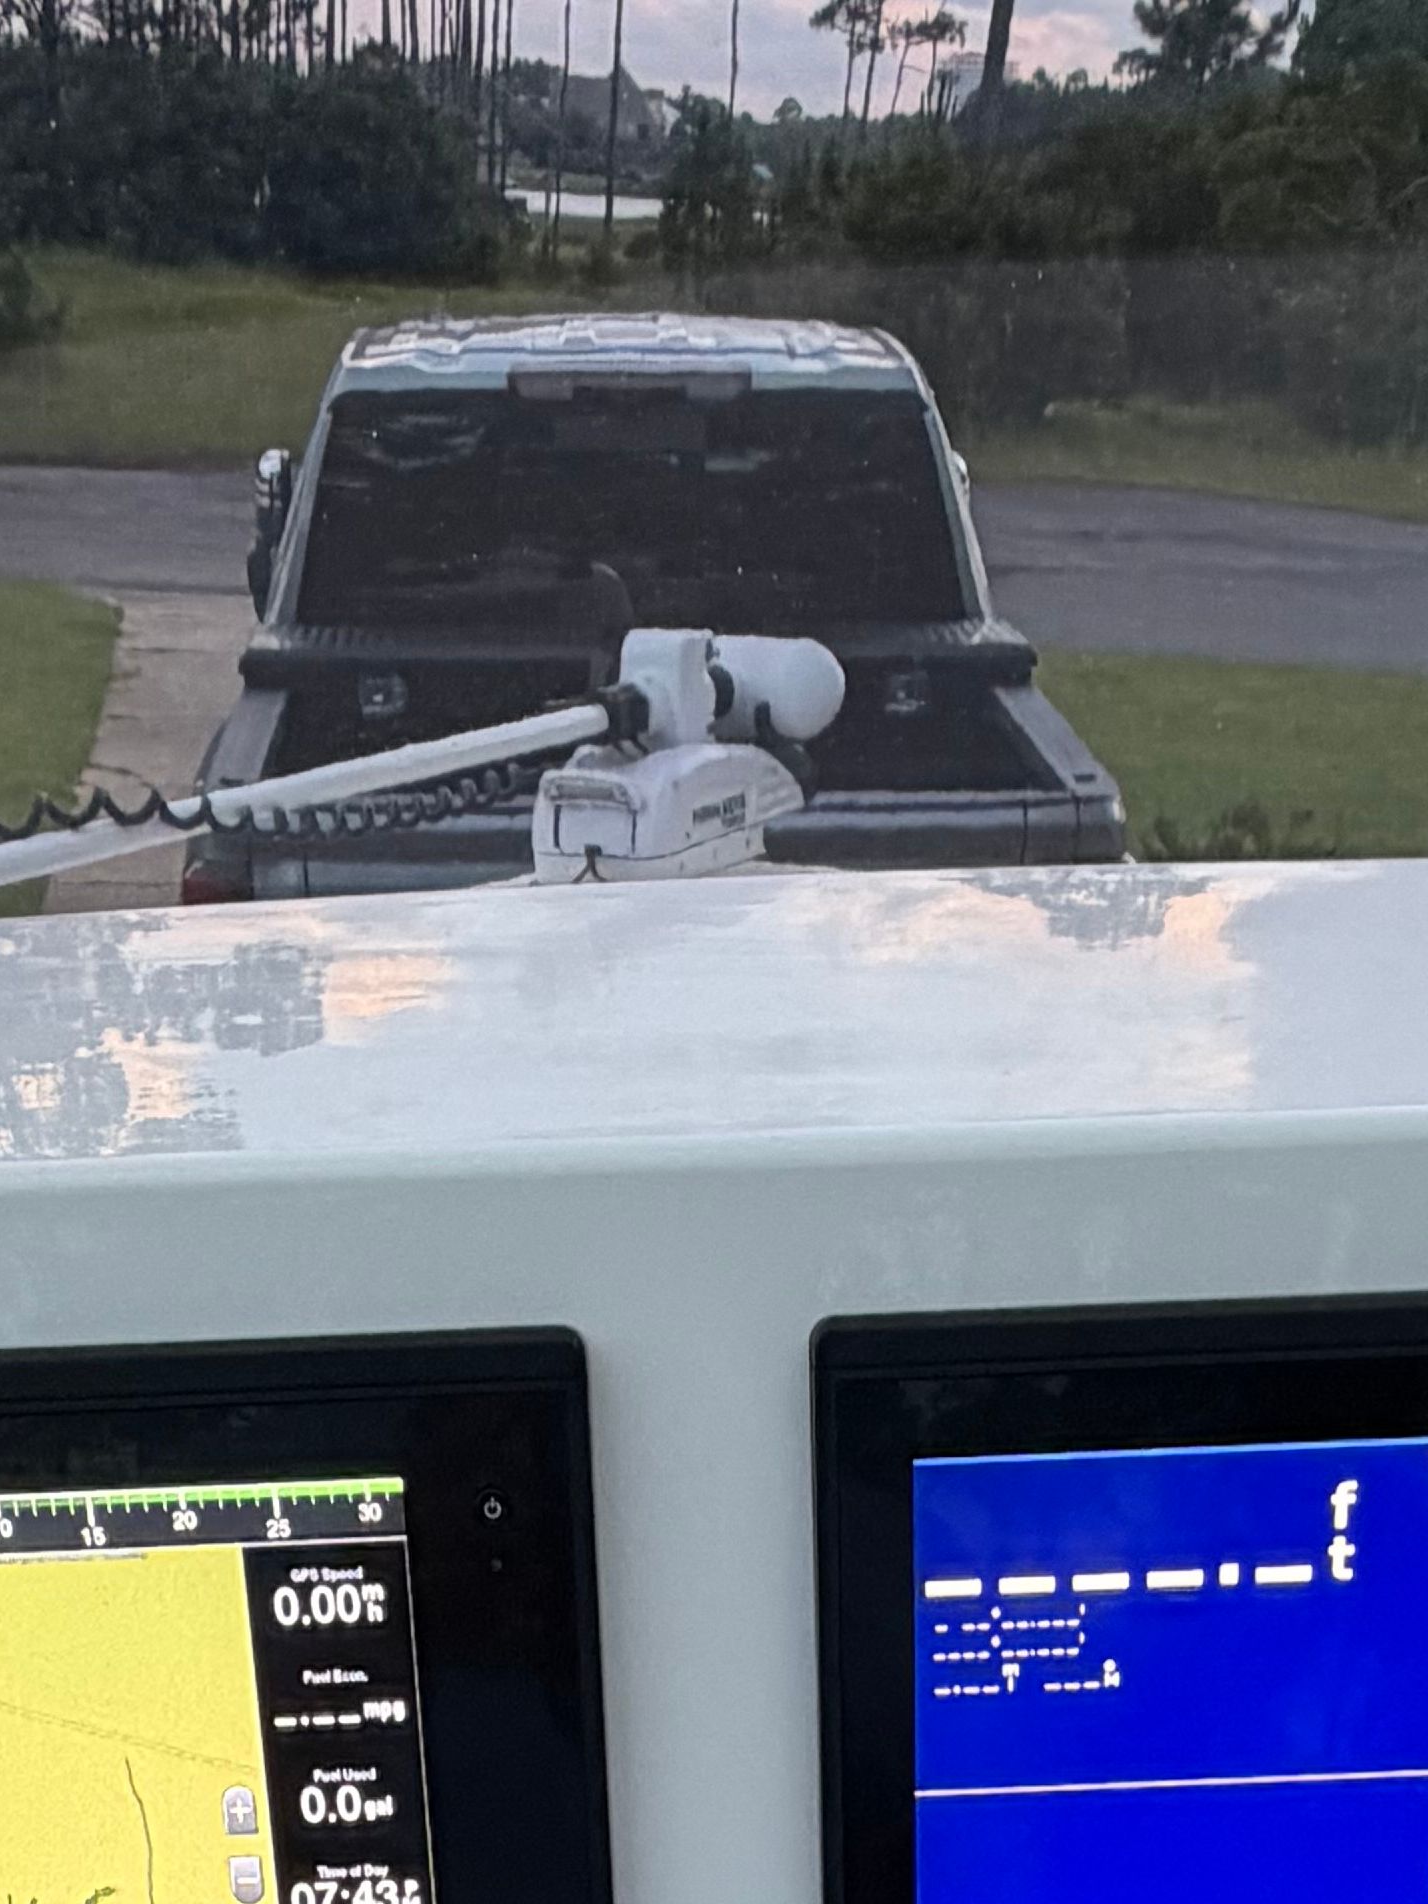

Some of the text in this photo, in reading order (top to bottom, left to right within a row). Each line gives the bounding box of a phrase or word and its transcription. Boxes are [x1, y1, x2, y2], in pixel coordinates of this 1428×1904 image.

[172, 1510, 198, 1532] 20
[358, 1502, 383, 1523] 30
[80, 1525, 107, 1547] 15
[266, 1517, 292, 1540] 25
[273, 1584, 362, 1626] 0.00
[299, 1784, 394, 1824] 0.0 gal
